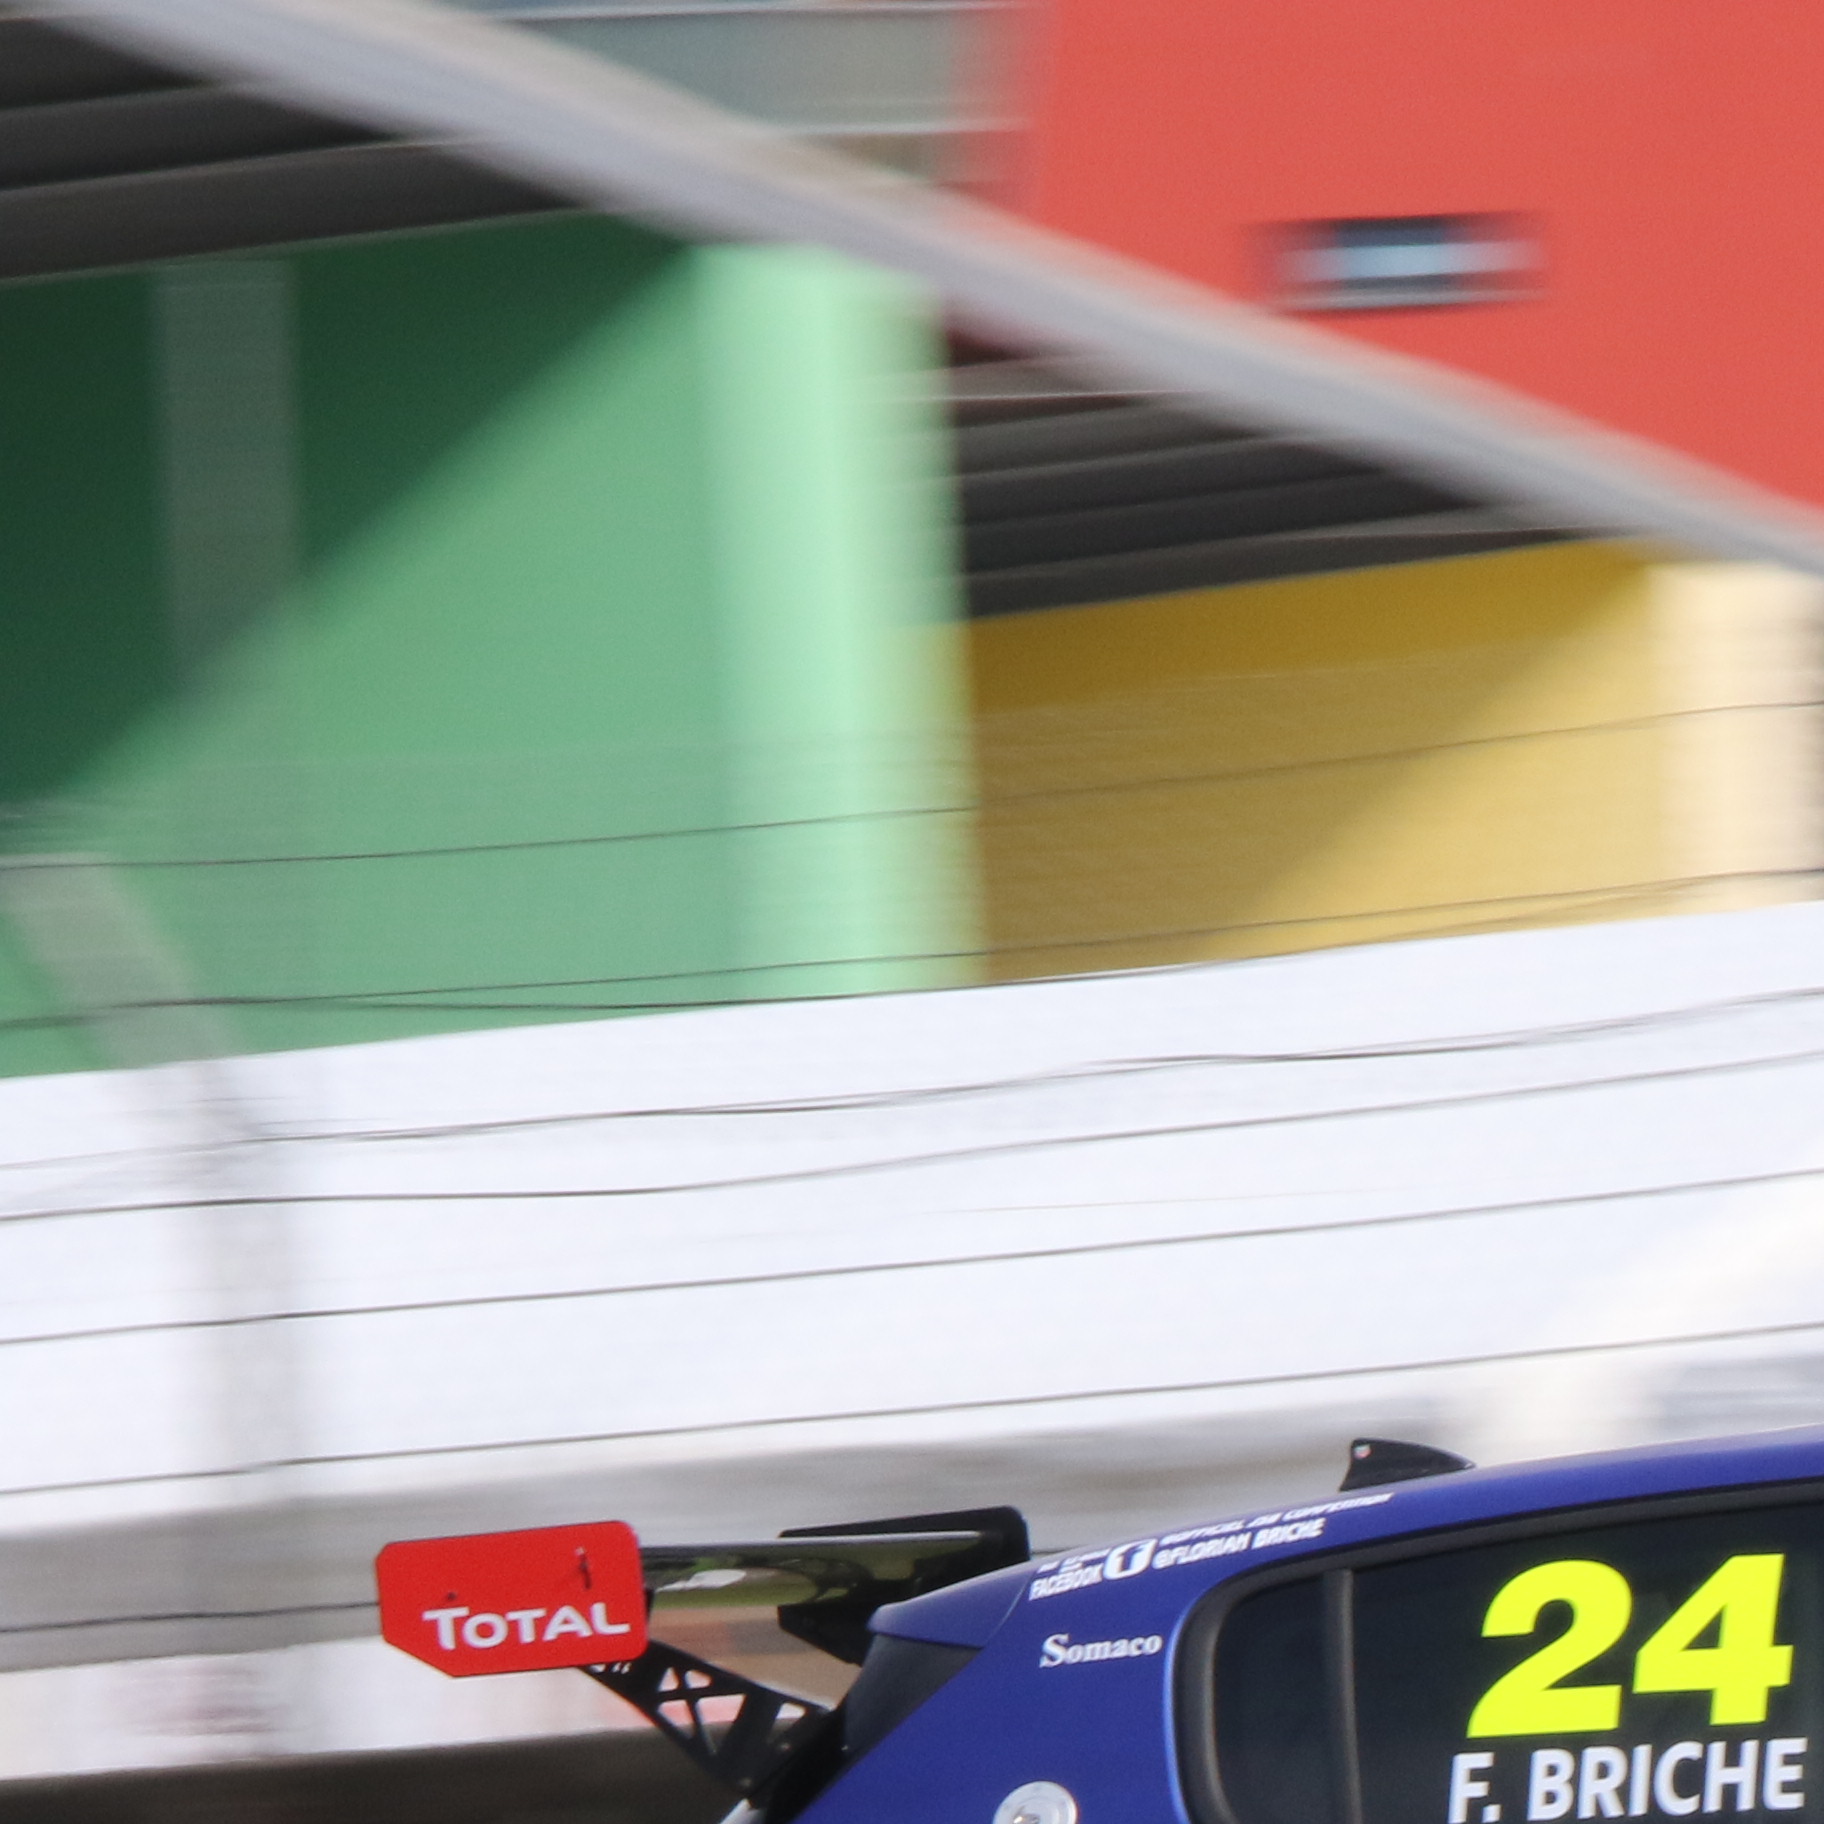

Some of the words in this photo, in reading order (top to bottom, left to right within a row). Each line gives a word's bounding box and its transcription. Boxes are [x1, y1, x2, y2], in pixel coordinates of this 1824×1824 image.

[1252, 1516, 1326, 1549] BRICHE
[422, 1601, 632, 1651] TOTAL
[1039, 1632, 1163, 1669] Somaco
[1466, 1552, 1795, 1739] 24
[1526, 1736, 1809, 1822] BRICHE
